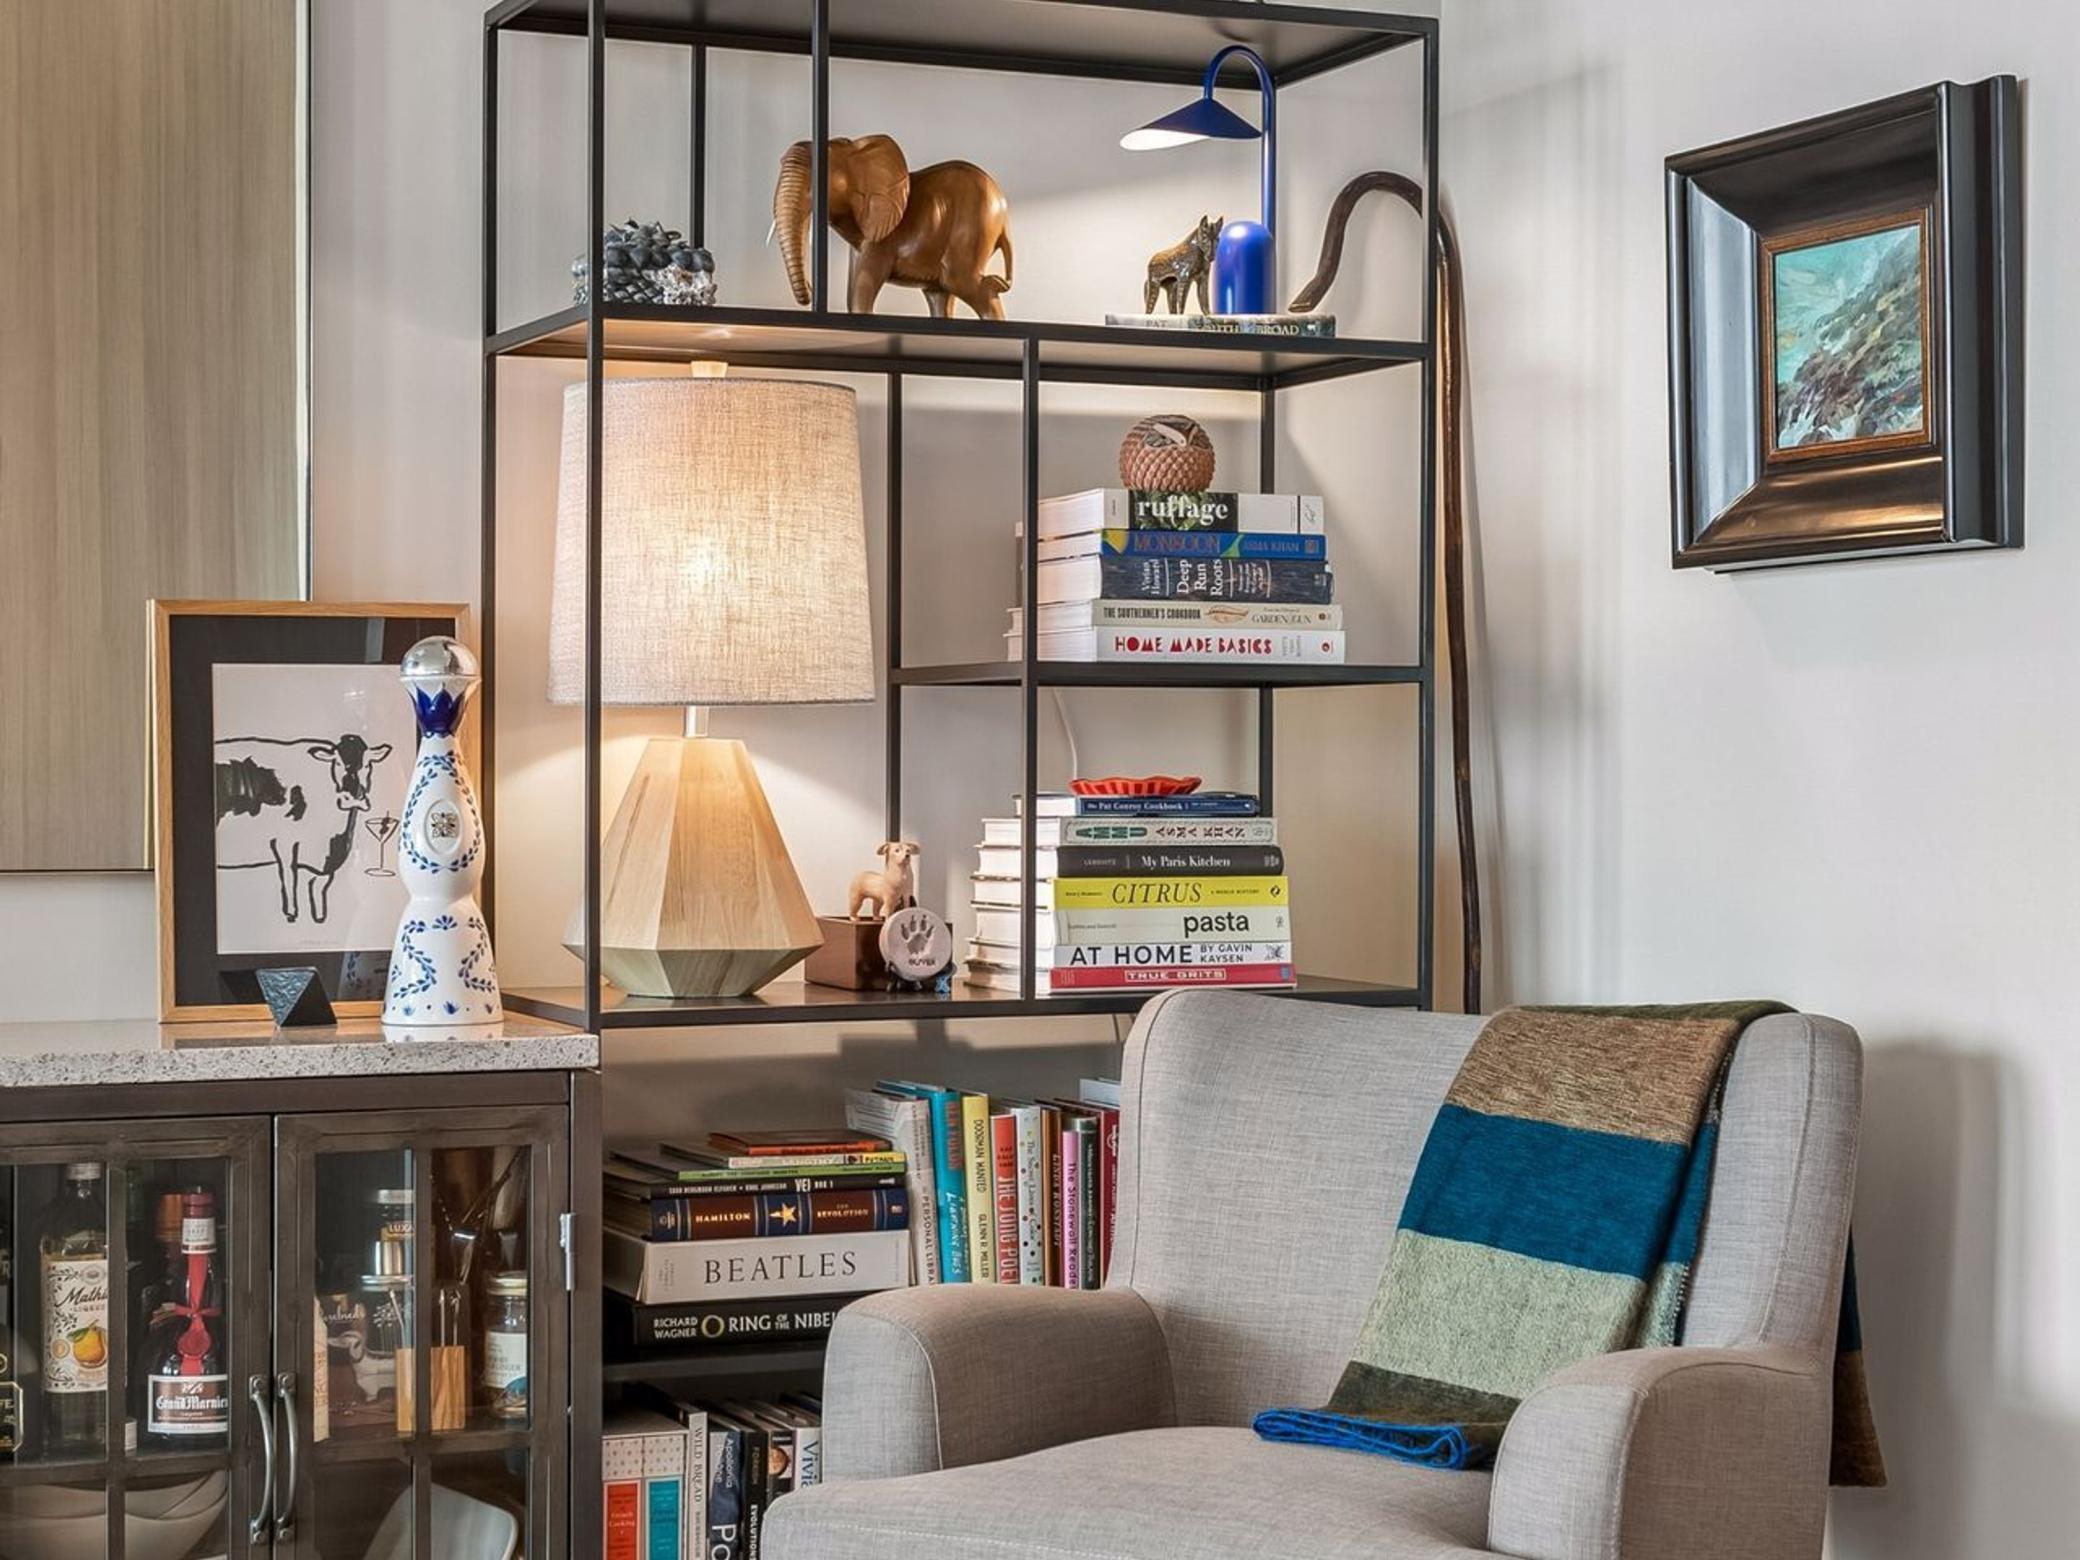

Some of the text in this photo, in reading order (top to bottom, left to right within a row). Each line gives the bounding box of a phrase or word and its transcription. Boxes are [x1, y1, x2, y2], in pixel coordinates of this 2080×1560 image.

[1137, 494, 1229, 527] ruffage
[1134, 533, 1220, 552] MONSOON
[1176, 559, 1193, 594] Deep
[1194, 563, 1207, 591] Run
[1210, 558, 1224, 597] Roots
[1103, 607, 1116, 619] THE
[1166, 608, 1201, 620] COOKBOOK
[1115, 636, 1163, 653] HOME
[1169, 636, 1212, 653] MADE
[1218, 637, 1272, 655] BASICS
[1143, 802, 1183, 810] Cookbook
[1155, 826, 1246, 839] ASMA KHAN
[1141, 854, 1231, 871] My Paris Kitchen
[1111, 882, 1203, 904] CITRUS
[1183, 912, 1250, 938] pasta
[1069, 945, 1193, 966] AT HOME
[1200, 943, 1253, 953] BY GAVIN
[1200, 954, 1244, 963] KAYSEN
[1127, 970, 1225, 980] TRUE GRITS
[974, 1119, 987, 1193] DOORMAN WANTED
[1067, 1162, 1077, 1182] The
[695, 1211, 751, 1223] HAMILTON
[817, 1208, 869, 1219] REVOLUTION
[922, 1196, 933, 1249] PERSONAL
[1067, 1186, 1077, 1244] Stonewall
[978, 1213, 988, 1240] GLENN
[704, 1250, 857, 1285] BEATLES
[980, 1251, 989, 1279] MILLER
[653, 1315, 698, 1328] RICHARD
[728, 1314, 772, 1333] RING
[774, 1321, 790, 1330] THE
[776, 1313, 788, 1322] OF
[653, 1327, 698, 1339] WAGNER
[693, 1427, 703, 1502] WILD BREAD
[726, 1438, 734, 1488] Apollonia
